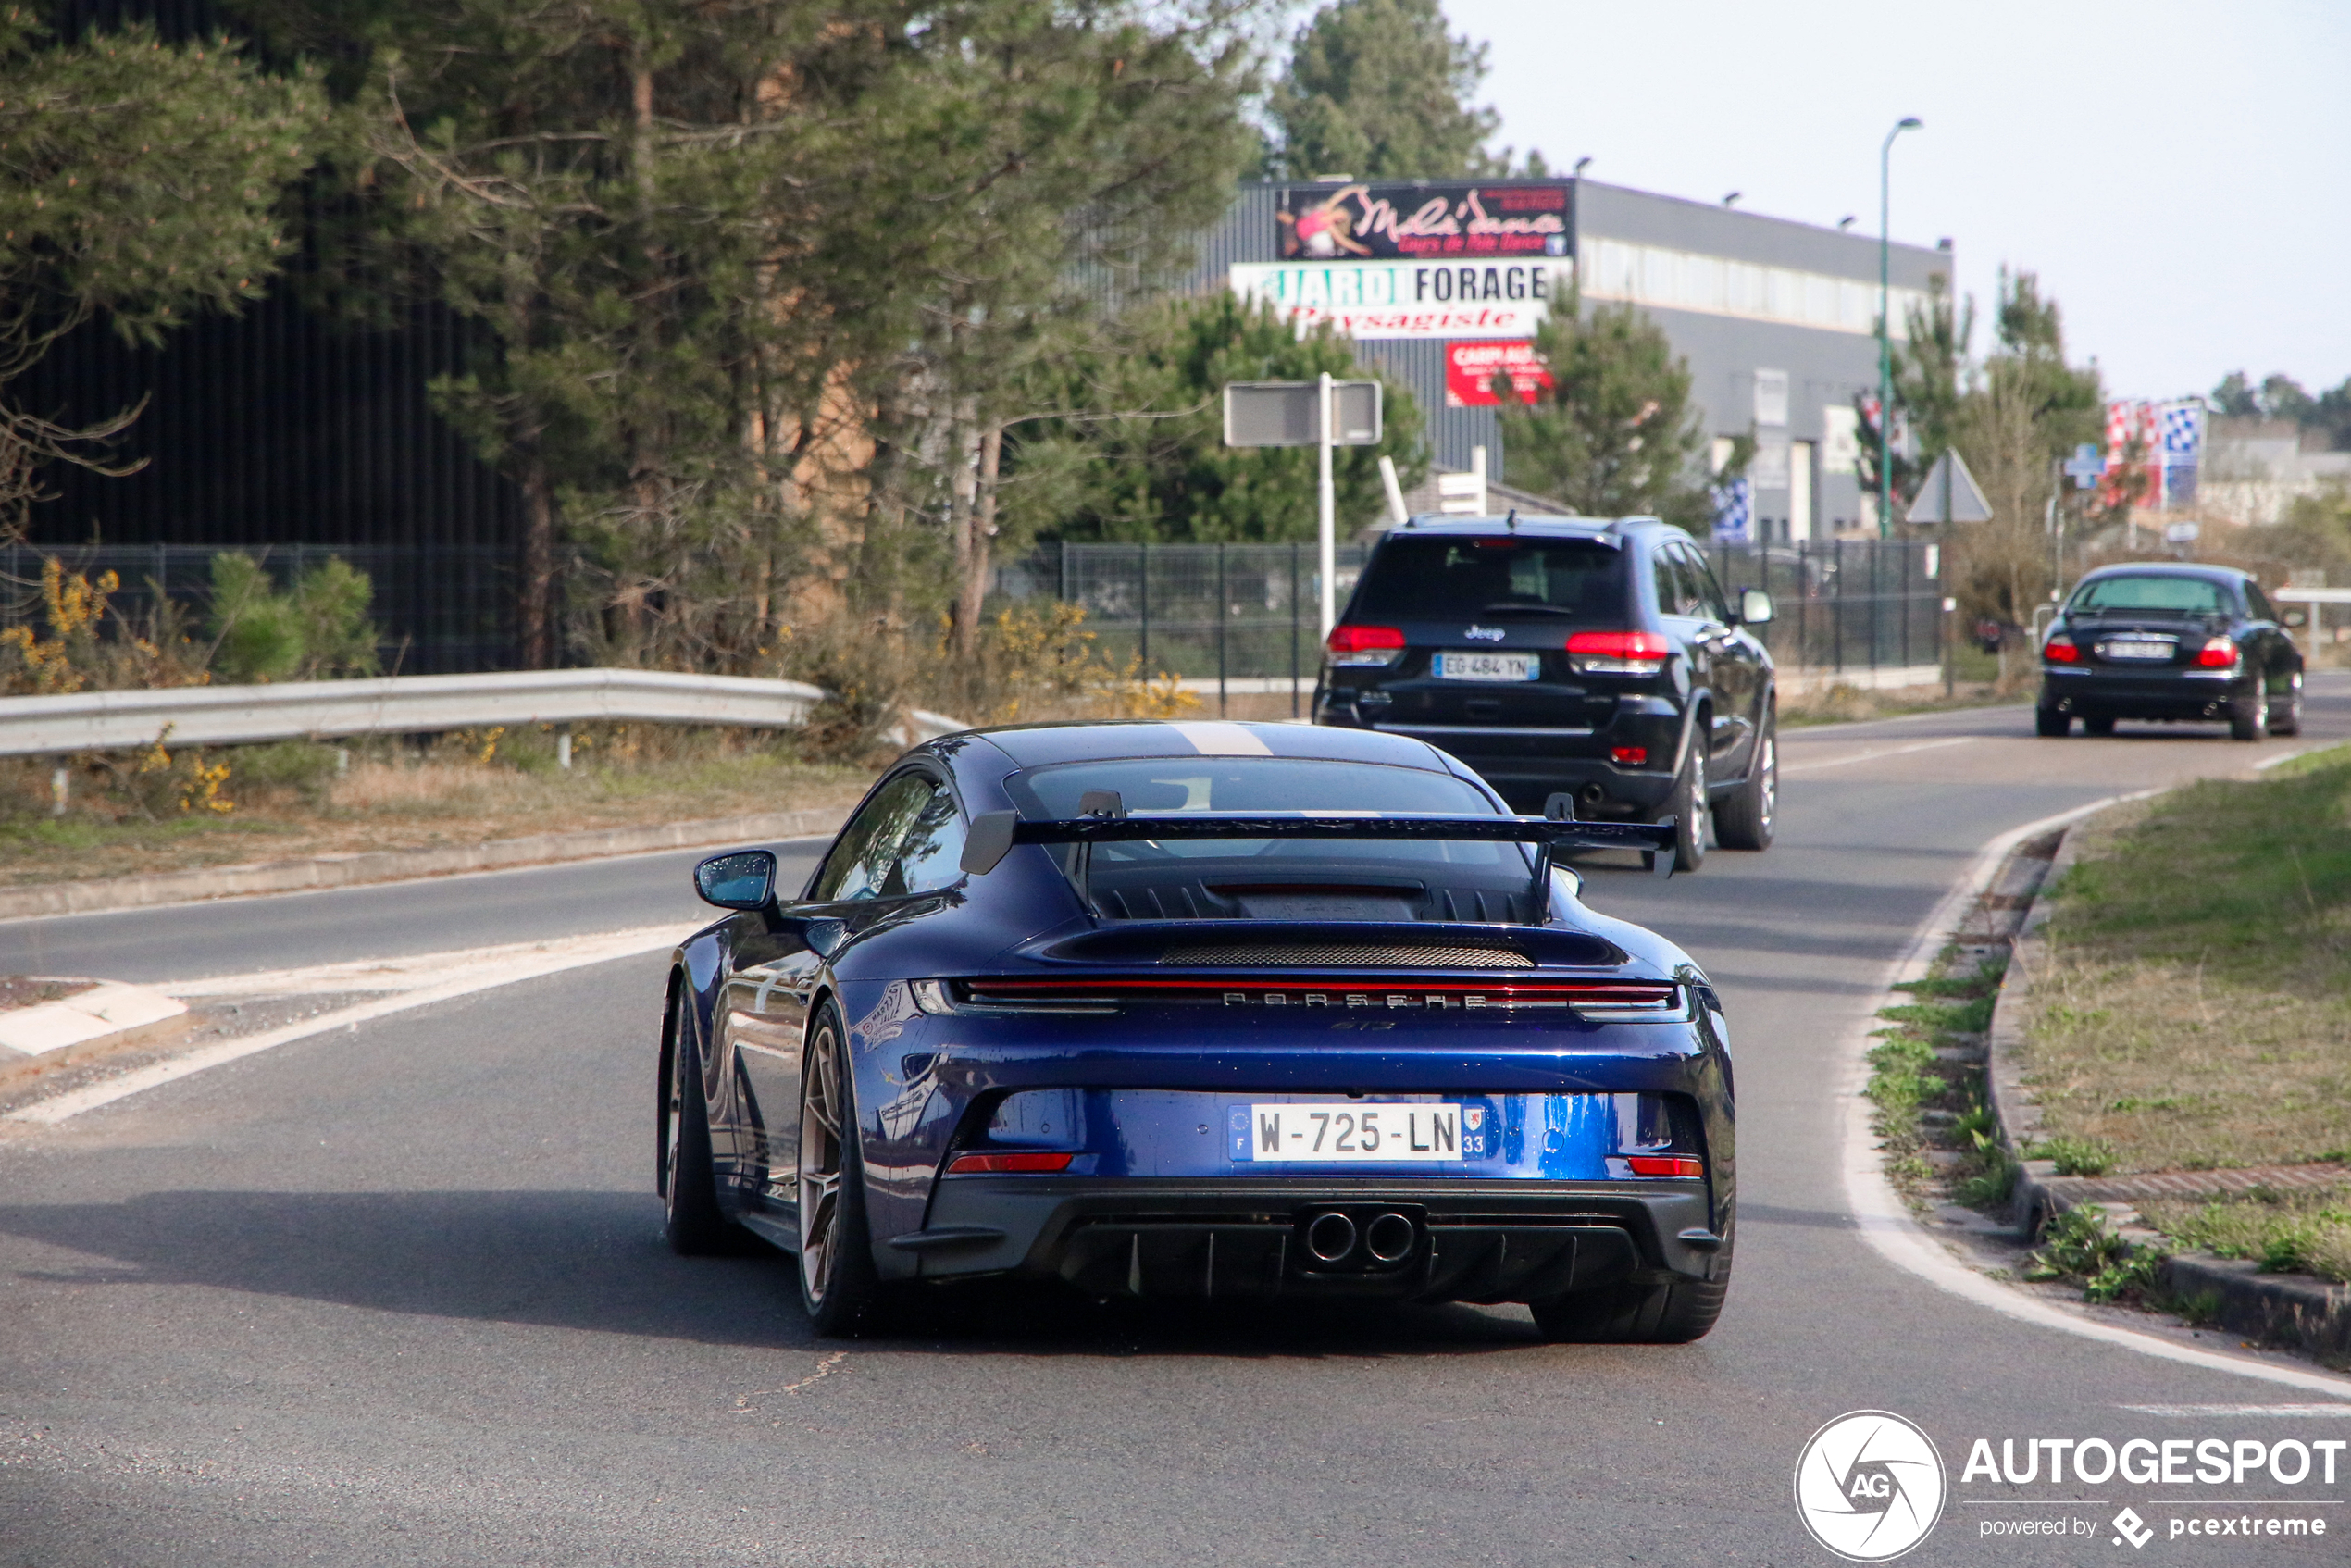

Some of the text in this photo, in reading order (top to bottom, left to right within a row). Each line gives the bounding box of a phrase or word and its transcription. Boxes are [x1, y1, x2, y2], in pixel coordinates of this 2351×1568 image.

[1282, 267, 1547, 305] JARDI FORAGE
[1464, 624, 1506, 642] Jeep
[1223, 993, 1486, 1009] PORSCHE
[1260, 1113, 1454, 1152] W-725-LN
[1236, 1138, 1245, 1150] F
[1463, 1135, 1484, 1153] 33
